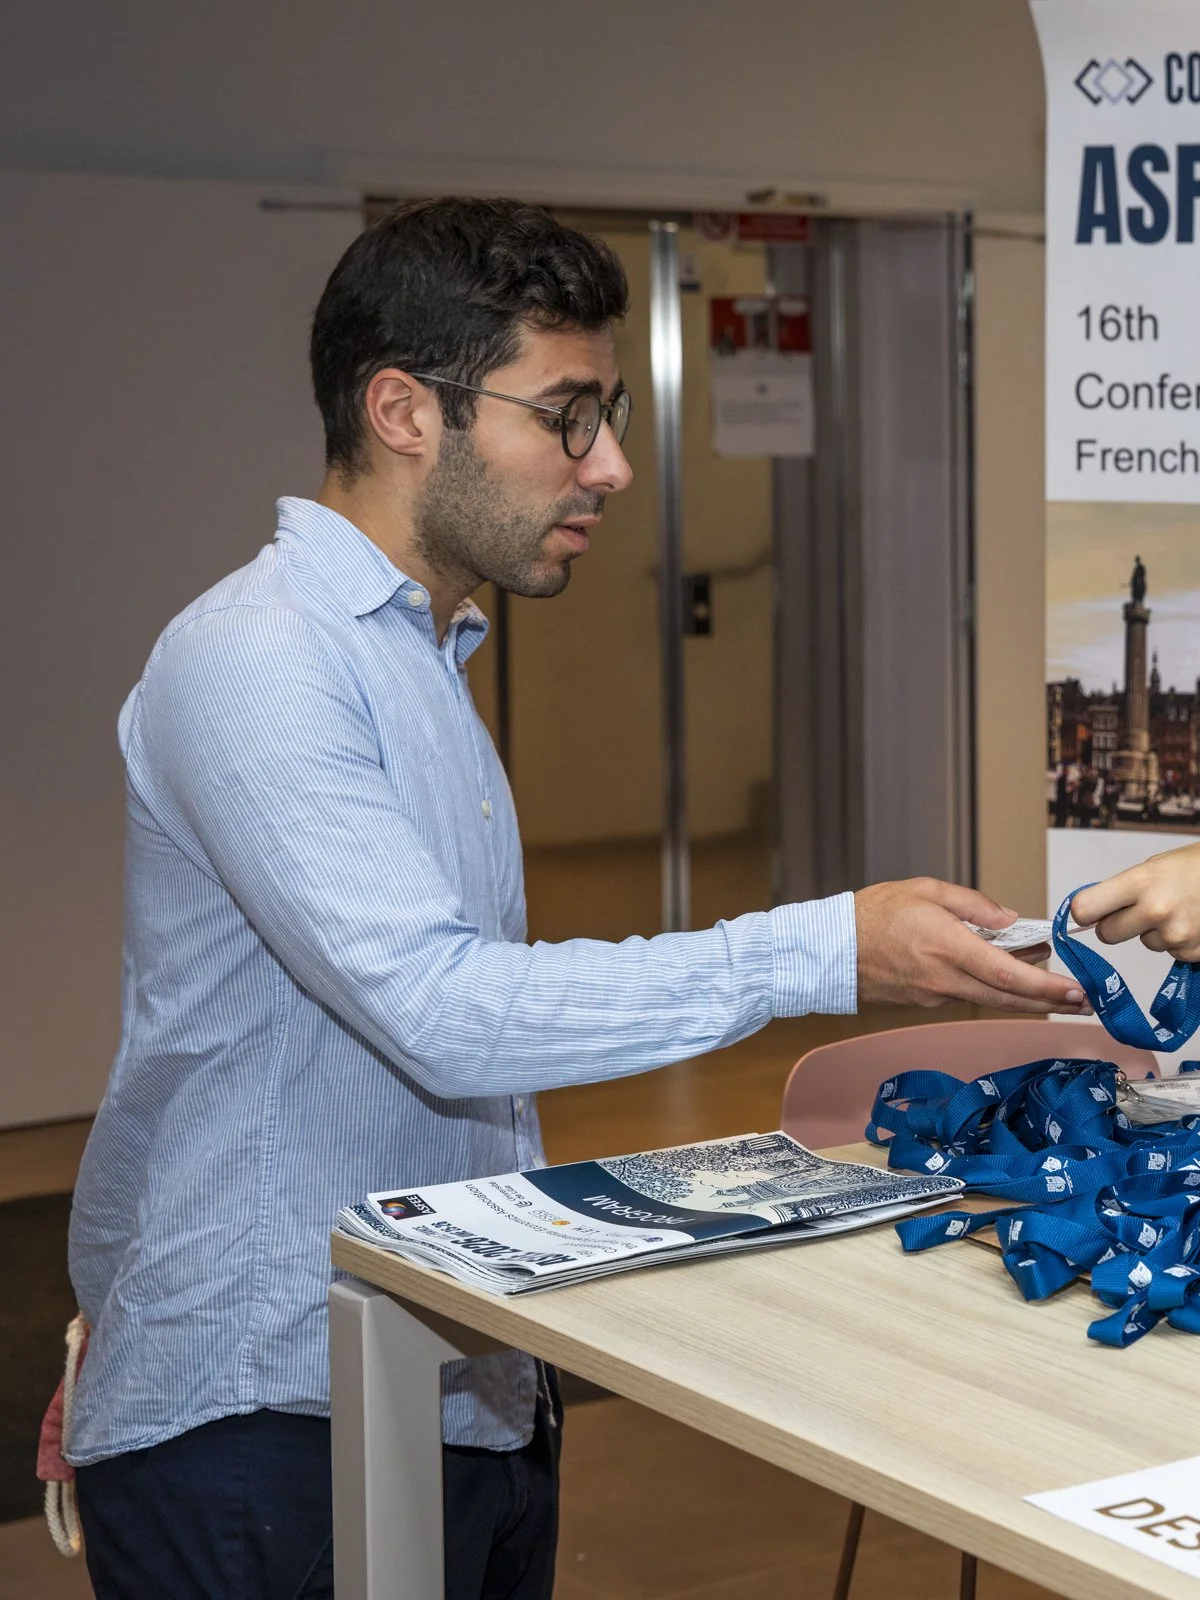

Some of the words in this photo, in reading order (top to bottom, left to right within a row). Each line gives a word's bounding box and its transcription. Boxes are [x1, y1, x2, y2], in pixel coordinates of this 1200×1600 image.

[1077, 304, 1160, 342] 16th
[1076, 438, 1200, 474] French
[406, 1194, 437, 1216] ASFEE
[465, 1184, 507, 1216] Association
[582, 1194, 696, 1225] PROGRAM
[450, 1236, 523, 1258] 2026
